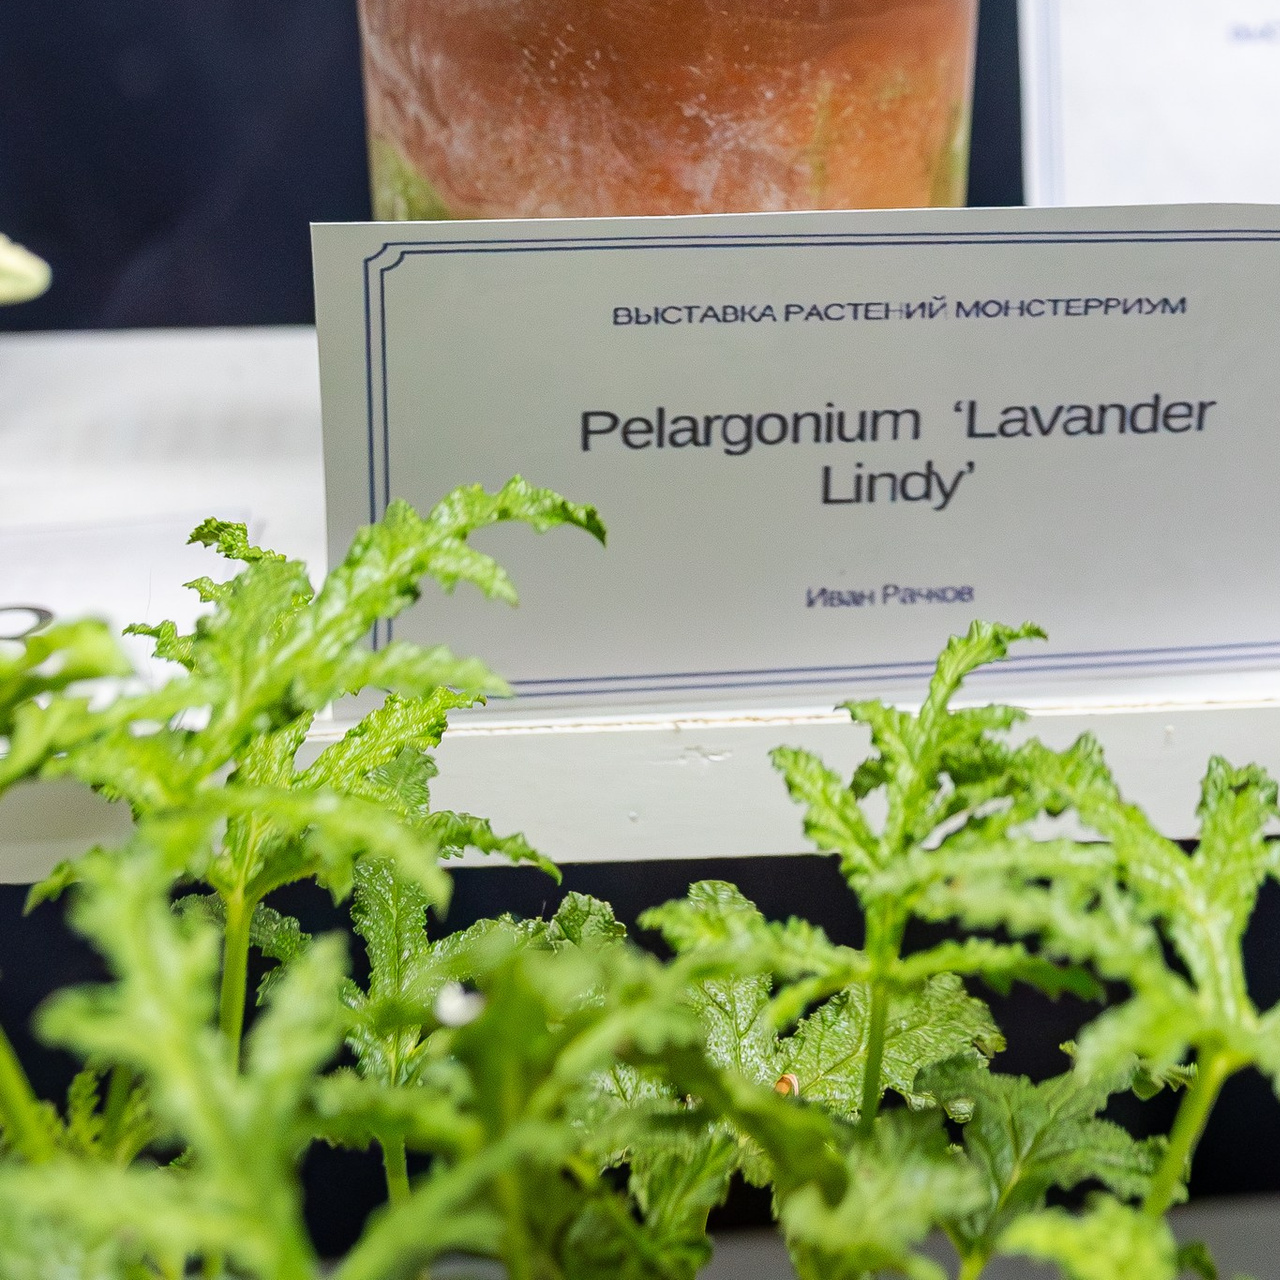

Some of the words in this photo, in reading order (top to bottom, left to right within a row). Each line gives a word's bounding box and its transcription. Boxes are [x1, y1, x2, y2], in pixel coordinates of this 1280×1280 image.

[612, 304, 777, 326] ВЫСТАВКА
[784, 295, 948, 322] РАСТЕНИЙ
[955, 296, 1187, 319] МОНСТЕРРИУМ
[580, 402, 921, 456] Pelargonium
[952, 393, 1217, 439] ‘Lavander
[821, 460, 975, 512] Lindy’
[806, 587, 876, 608] Иван
